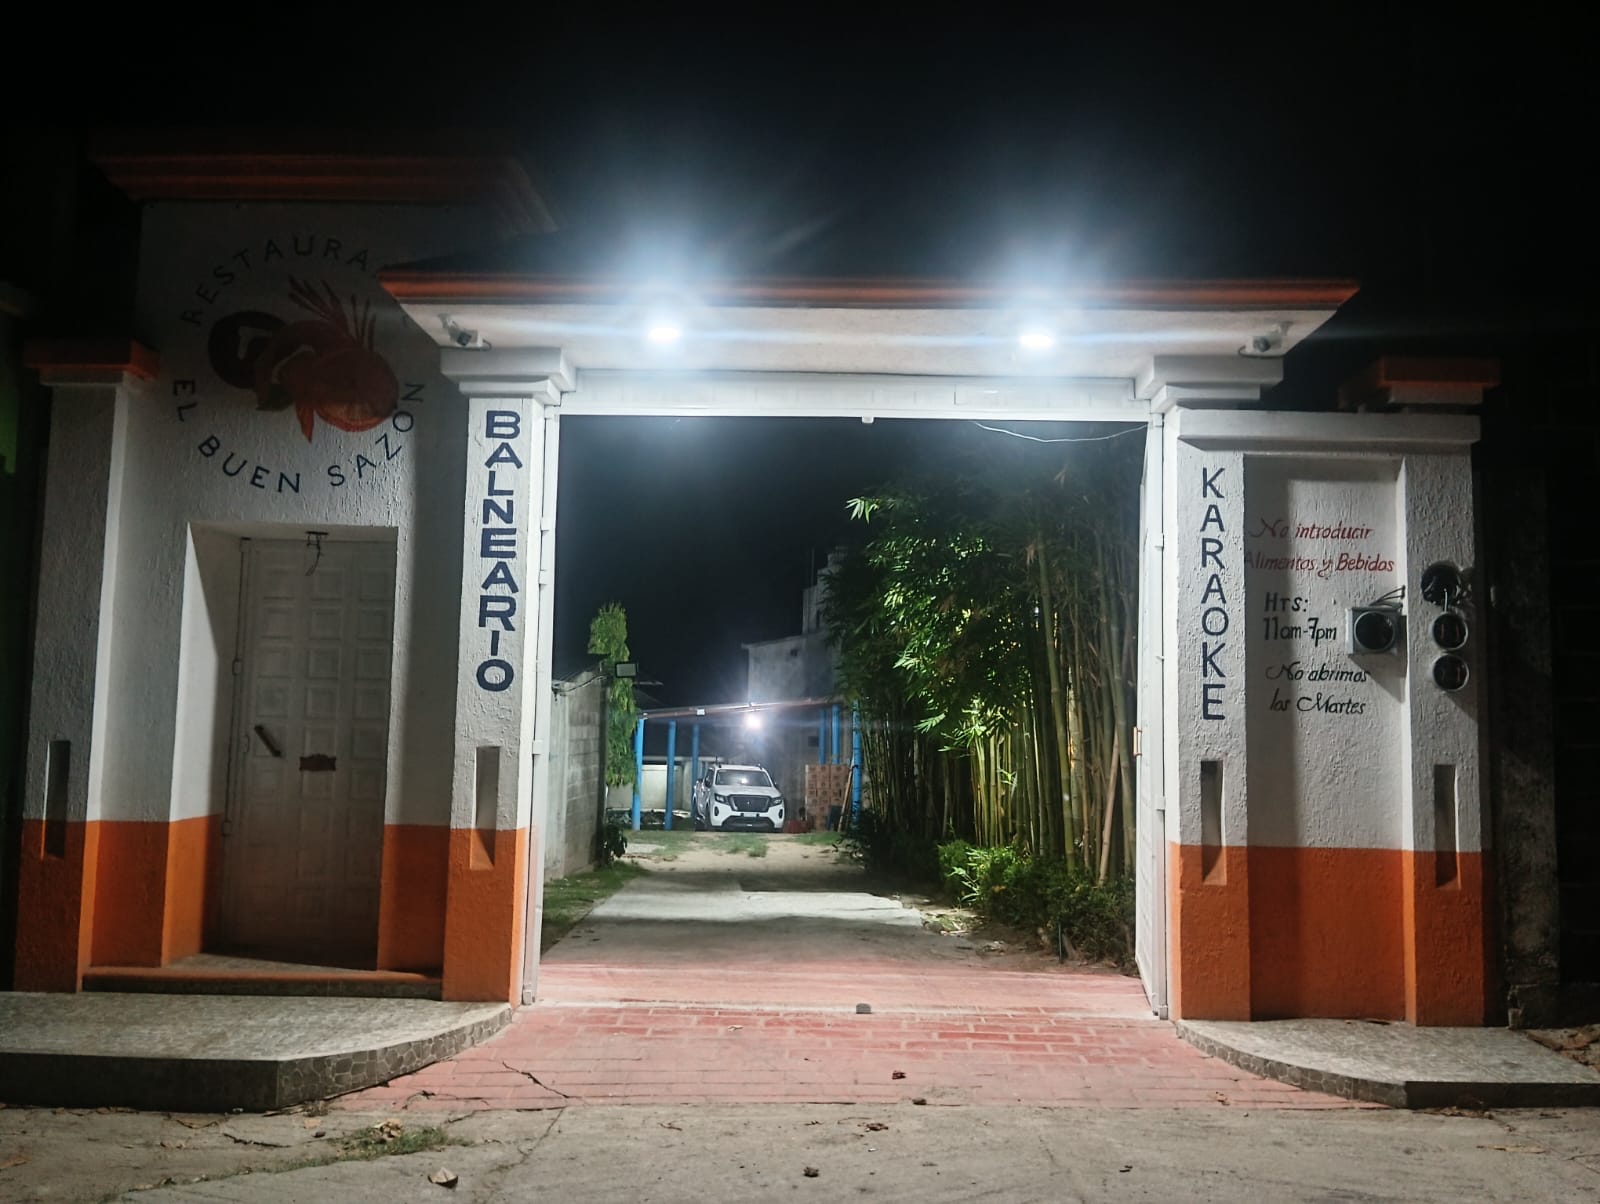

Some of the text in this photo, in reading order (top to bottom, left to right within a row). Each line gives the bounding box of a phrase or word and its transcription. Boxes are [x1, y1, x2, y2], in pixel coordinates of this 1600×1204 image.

[181, 235, 370, 326] RESTAURA
[173, 379, 198, 422] EL
[198, 435, 300, 493] BUEN
[1251, 517, 1373, 539] No introducir
[476, 410, 523, 692] BALNEARIO
[1244, 552, 1314, 571] Alimentos
[1200, 467, 1229, 720] KARAOKE
[1263, 617, 1337, 647] 11am-7pm
[1265, 661, 1372, 683] No abrimos
[1296, 692, 1366, 715] Martes
